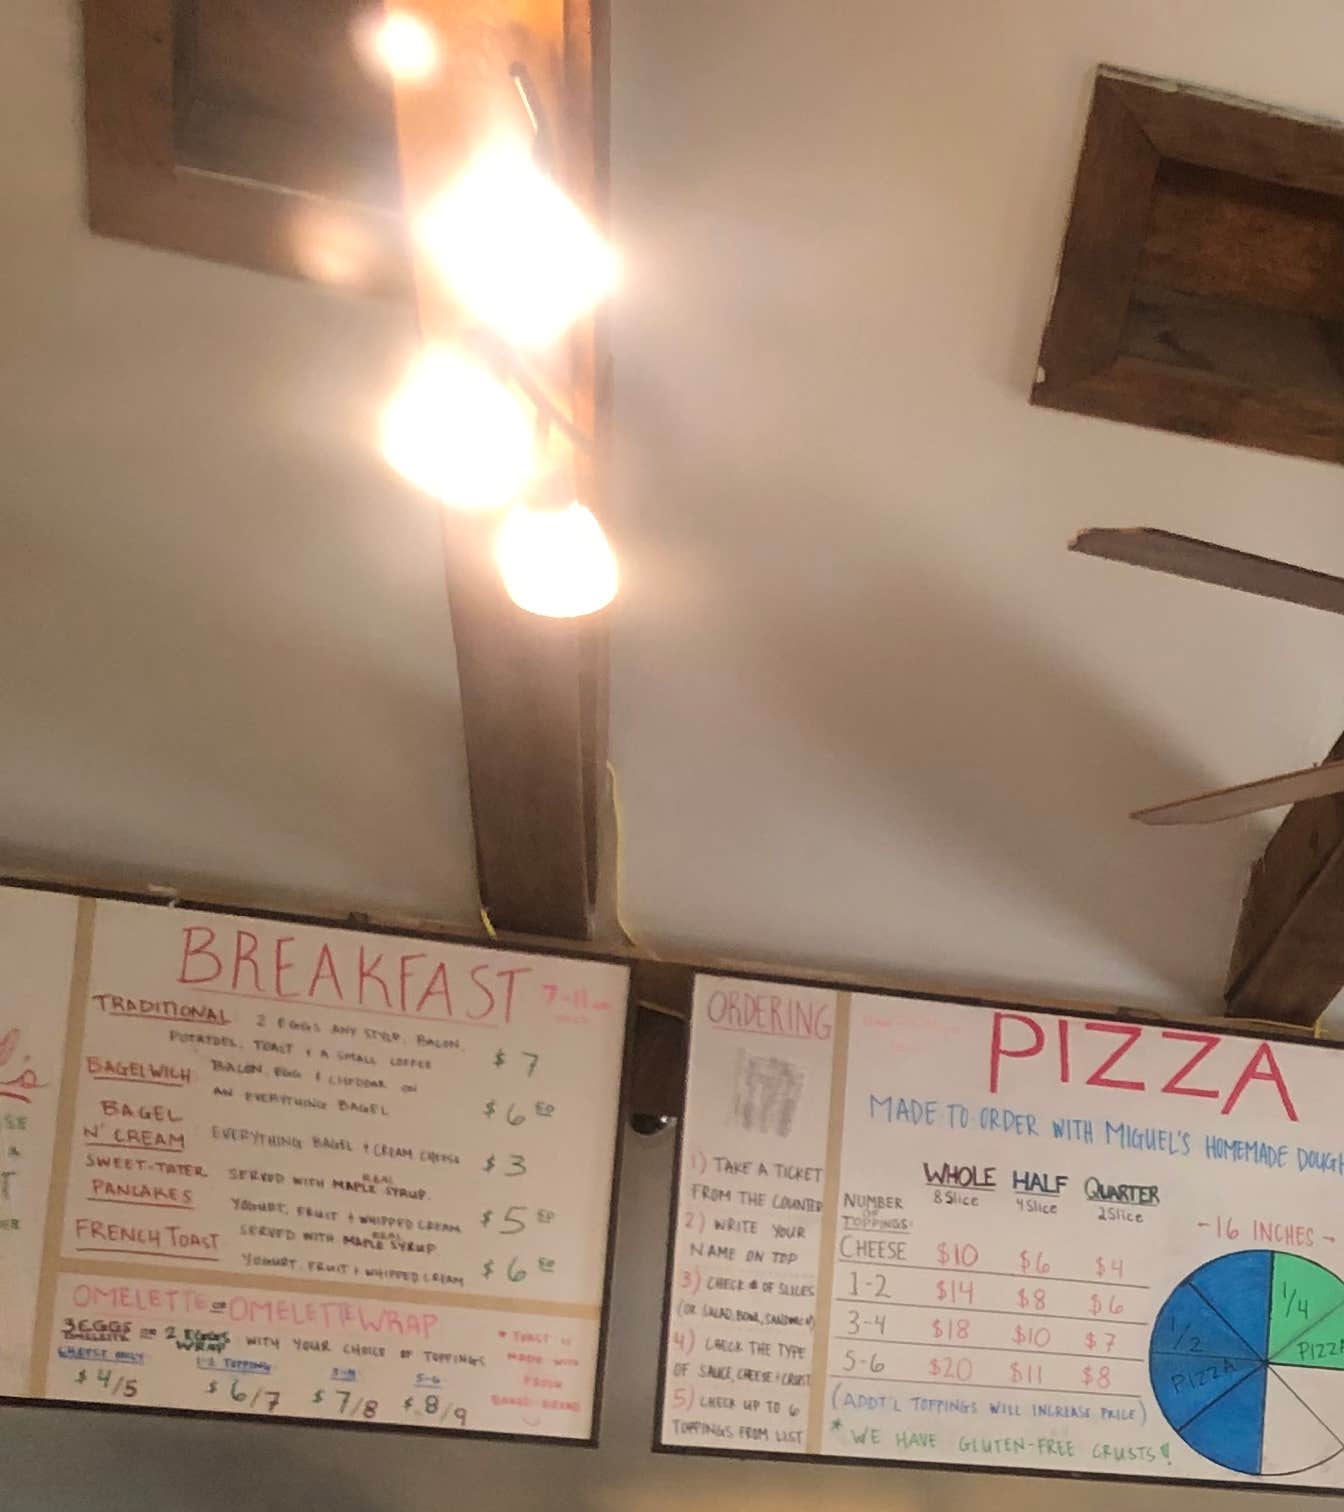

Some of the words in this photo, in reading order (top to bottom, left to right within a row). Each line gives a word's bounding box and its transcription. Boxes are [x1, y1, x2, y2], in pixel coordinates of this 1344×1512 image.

[177, 925, 533, 1024] BREAKFAST
[92, 994, 232, 1023] TRADITIONAL
[707, 991, 832, 1040] ORDERING
[331, 1023, 357, 1038] ANY
[87, 1056, 191, 1083] BAGELWICH
[990, 1012, 1299, 1122] PIZZA
[100, 1100, 184, 1121] BAGEL
[114, 1129, 185, 1149] CREAM
[212, 1125, 302, 1150] EVERYTHING
[869, 1093, 937, 1125] MADE
[947, 1104, 968, 1128] TO
[980, 1107, 1039, 1137] ORDER
[1052, 1119, 1093, 1144] WITH
[1105, 1120, 1191, 1156] MIGUEL'S
[1204, 1134, 1289, 1168] HOMEMADE
[712, 1156, 752, 1175] TAKE
[758, 1162, 769, 1177] A
[774, 1163, 824, 1184] TICKET
[923, 1162, 997, 1187] WHOLE
[1012, 1170, 1069, 1194] HALF
[1083, 1176, 1160, 1205] QUARTER
[92, 1179, 193, 1204] PANCAKES
[690, 1183, 731, 1202] FROM
[737, 1190, 766, 1207] THE
[842, 1192, 904, 1210] NUMBER
[75, 1218, 161, 1247] FRENCH
[164, 1225, 220, 1250] TOAST
[714, 1217, 758, 1235] WRITE
[772, 1223, 806, 1239] YOUR
[1253, 1219, 1313, 1247] INCHES
[690, 1241, 735, 1261] NAME
[745, 1249, 765, 1263] ON
[771, 1251, 798, 1265] TOP
[840, 1235, 908, 1261] CHEESE
[936, 1242, 979, 1268] $10
[73, 1284, 207, 1314] OMELETTE
[706, 1276, 744, 1291] CHECK
[779, 1282, 815, 1297] SLICES
[850, 1271, 892, 1300] 1-2
[936, 1280, 974, 1304] $14
[1017, 1288, 1046, 1311] $8
[848, 1310, 887, 1336] 3-4
[932, 1318, 971, 1341] $18
[1014, 1323, 1052, 1348] $10
[246, 1336, 280, 1350] WITH
[293, 1339, 331, 1353] YOUR
[343, 1343, 386, 1358] CHOICE
[423, 1350, 486, 1368] TOPPINGS
[705, 1338, 744, 1353] CHECK
[748, 1341, 771, 1358] THE
[778, 1343, 807, 1360] TYPE
[673, 1363, 690, 1377] OF
[842, 1349, 886, 1374] 5-6
[928, 1357, 973, 1382] $20
[1009, 1361, 1042, 1385] $11
[1080, 1365, 1111, 1389] $8
[1171, 1359, 1237, 1394] PIZZA
[700, 1395, 736, 1409] CHECK
[743, 1400, 760, 1412] UP
[766, 1401, 781, 1414] TO
[910, 1396, 977, 1415] TOPPINGS
[988, 1402, 1021, 1417] WILL
[1032, 1403, 1091, 1420] INCREASE
[672, 1419, 734, 1439] TOPPINGS
[740, 1426, 769, 1442] FROM
[775, 1430, 803, 1444] LIST
[850, 1426, 880, 1447] WE
[896, 1432, 937, 1449] HAVE
[958, 1437, 1075, 1459] GLUTEN-FREE
